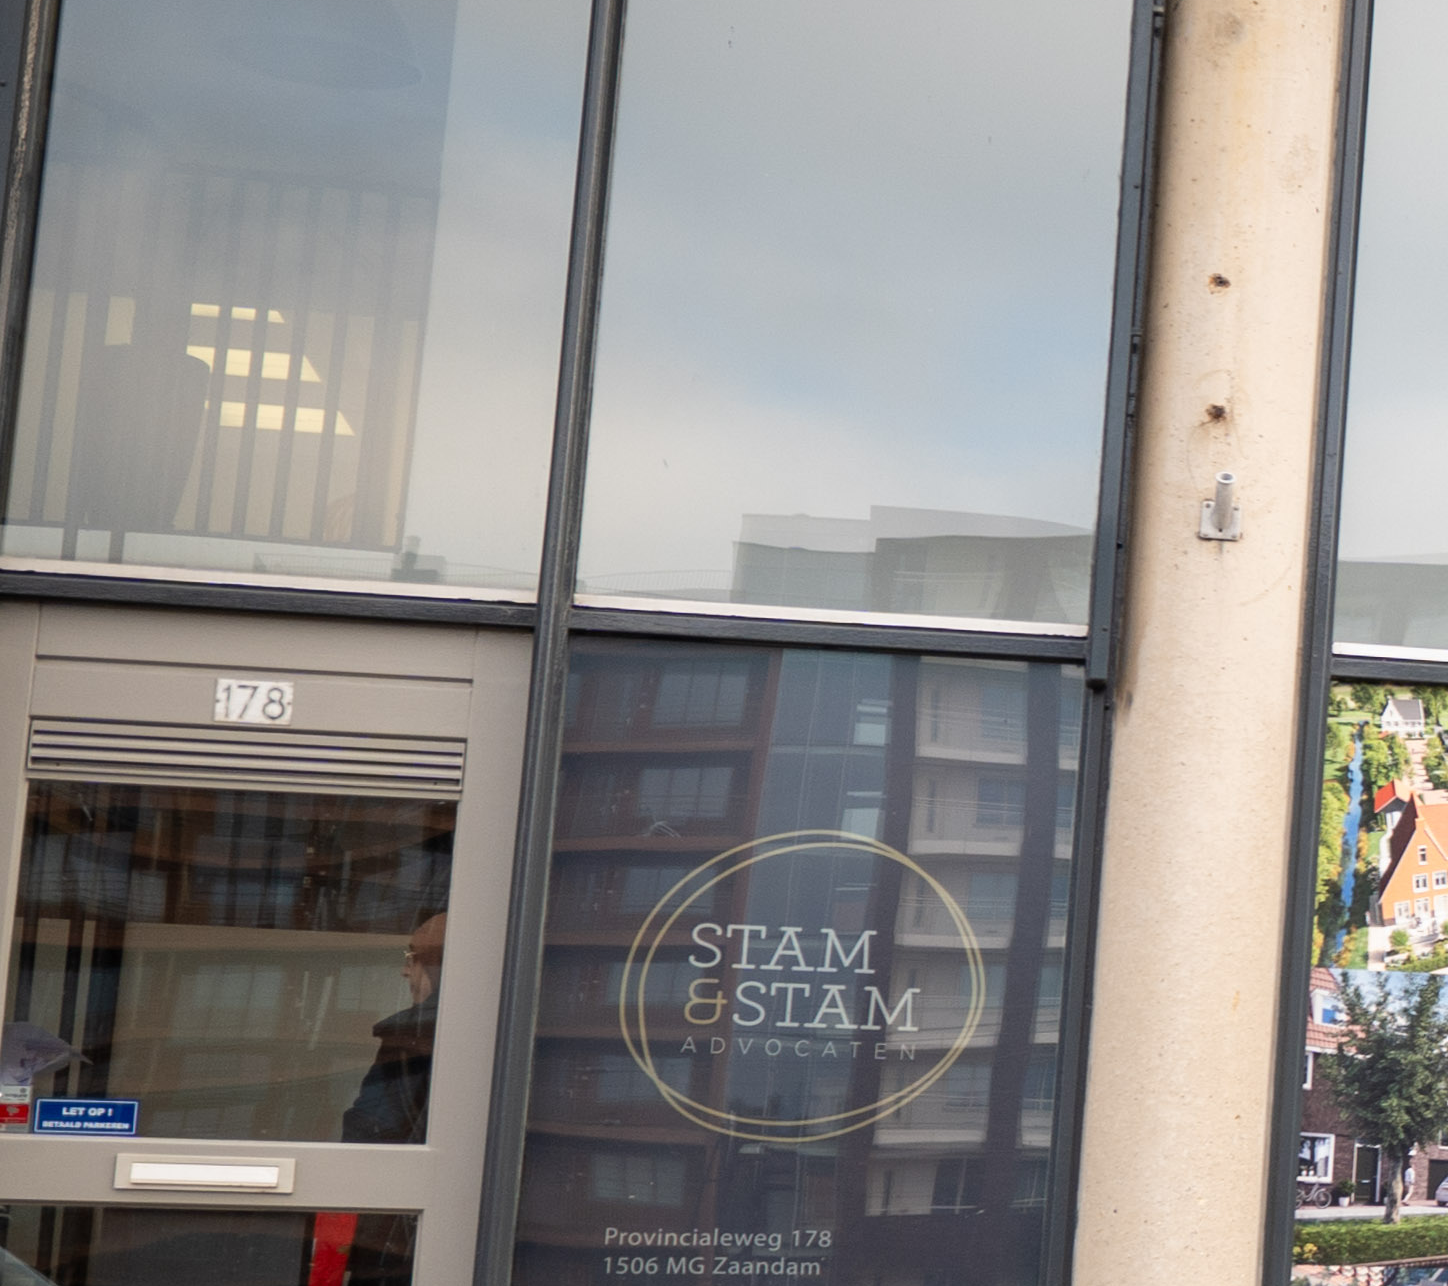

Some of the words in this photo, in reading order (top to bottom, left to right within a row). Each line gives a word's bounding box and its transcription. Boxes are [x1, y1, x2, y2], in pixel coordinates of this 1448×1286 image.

[222, 684, 285, 721] 178
[688, 922, 877, 974] STAM
[680, 1035, 916, 1061] ADVOCATEN
[61, 1106, 85, 1116] LET
[604, 1227, 782, 1251] Provincialeweg
[791, 1230, 832, 1248] 178
[604, 1257, 659, 1275] 1506
[666, 1257, 705, 1275] MG
[712, 1257, 821, 1276] Zaandam
